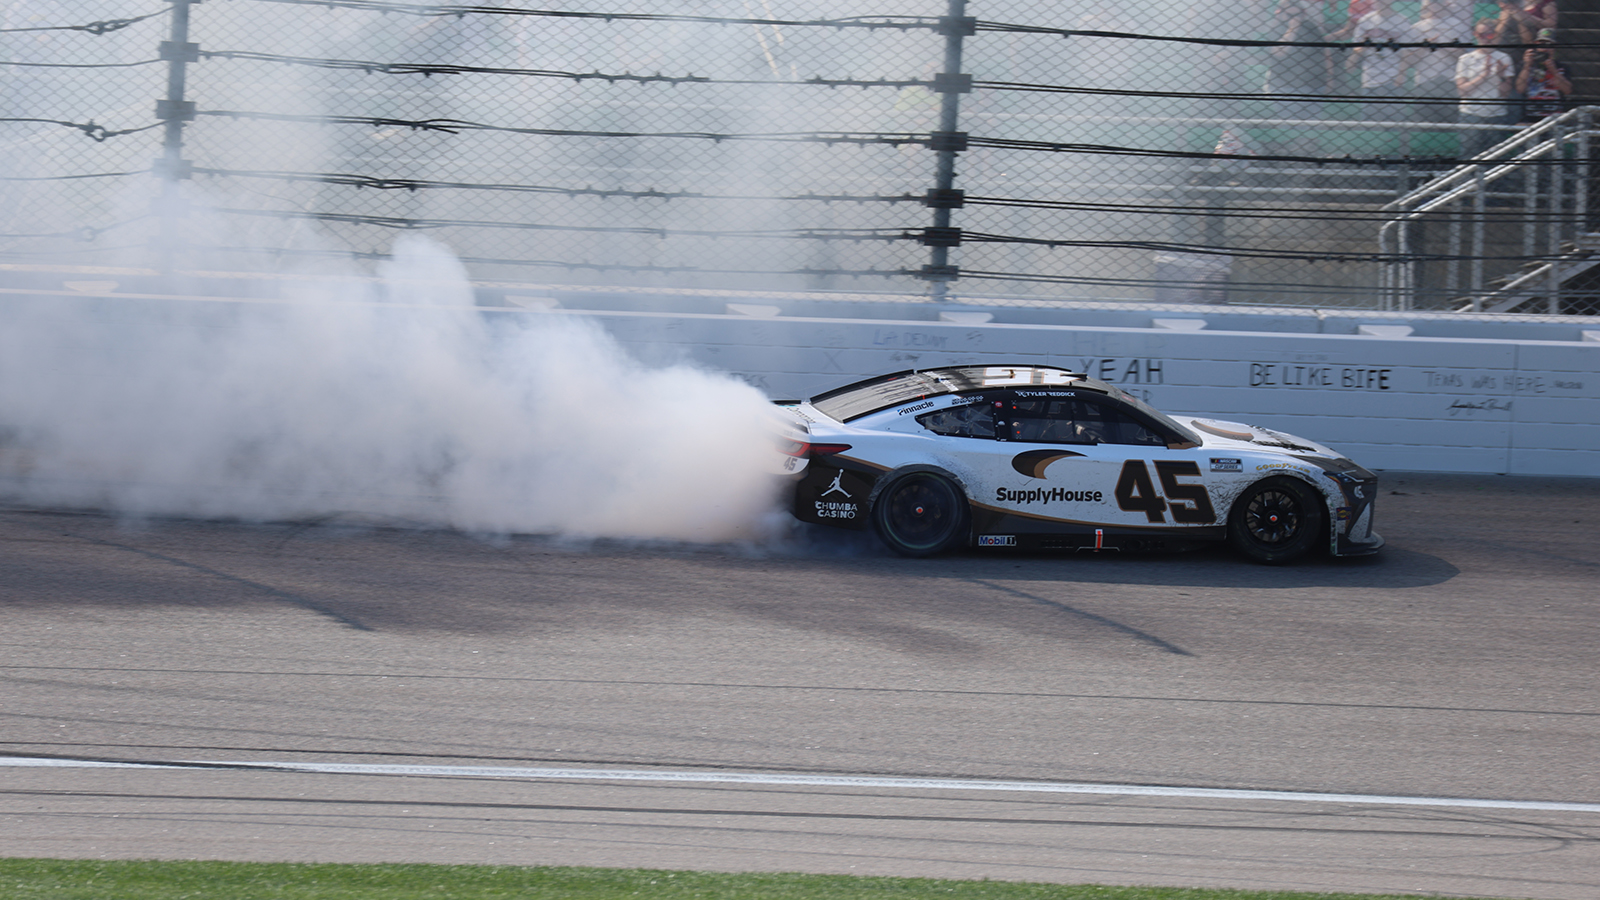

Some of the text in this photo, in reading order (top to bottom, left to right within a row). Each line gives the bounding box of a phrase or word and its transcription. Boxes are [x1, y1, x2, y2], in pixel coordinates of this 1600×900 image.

[1078, 358, 1164, 385] YEAH
[1248, 362, 1393, 390] BE LIKE BIFE
[1503, 375, 1547, 394] HERE
[897, 400, 935, 416] Pinnacle
[783, 456, 798, 471] 45
[996, 486, 1103, 505] SupplyHouse
[1114, 458, 1217, 525] 45
[815, 501, 858, 511] CHUMBA
[817, 509, 857, 520] CASINO
[978, 536, 1016, 546] Mobil 1
